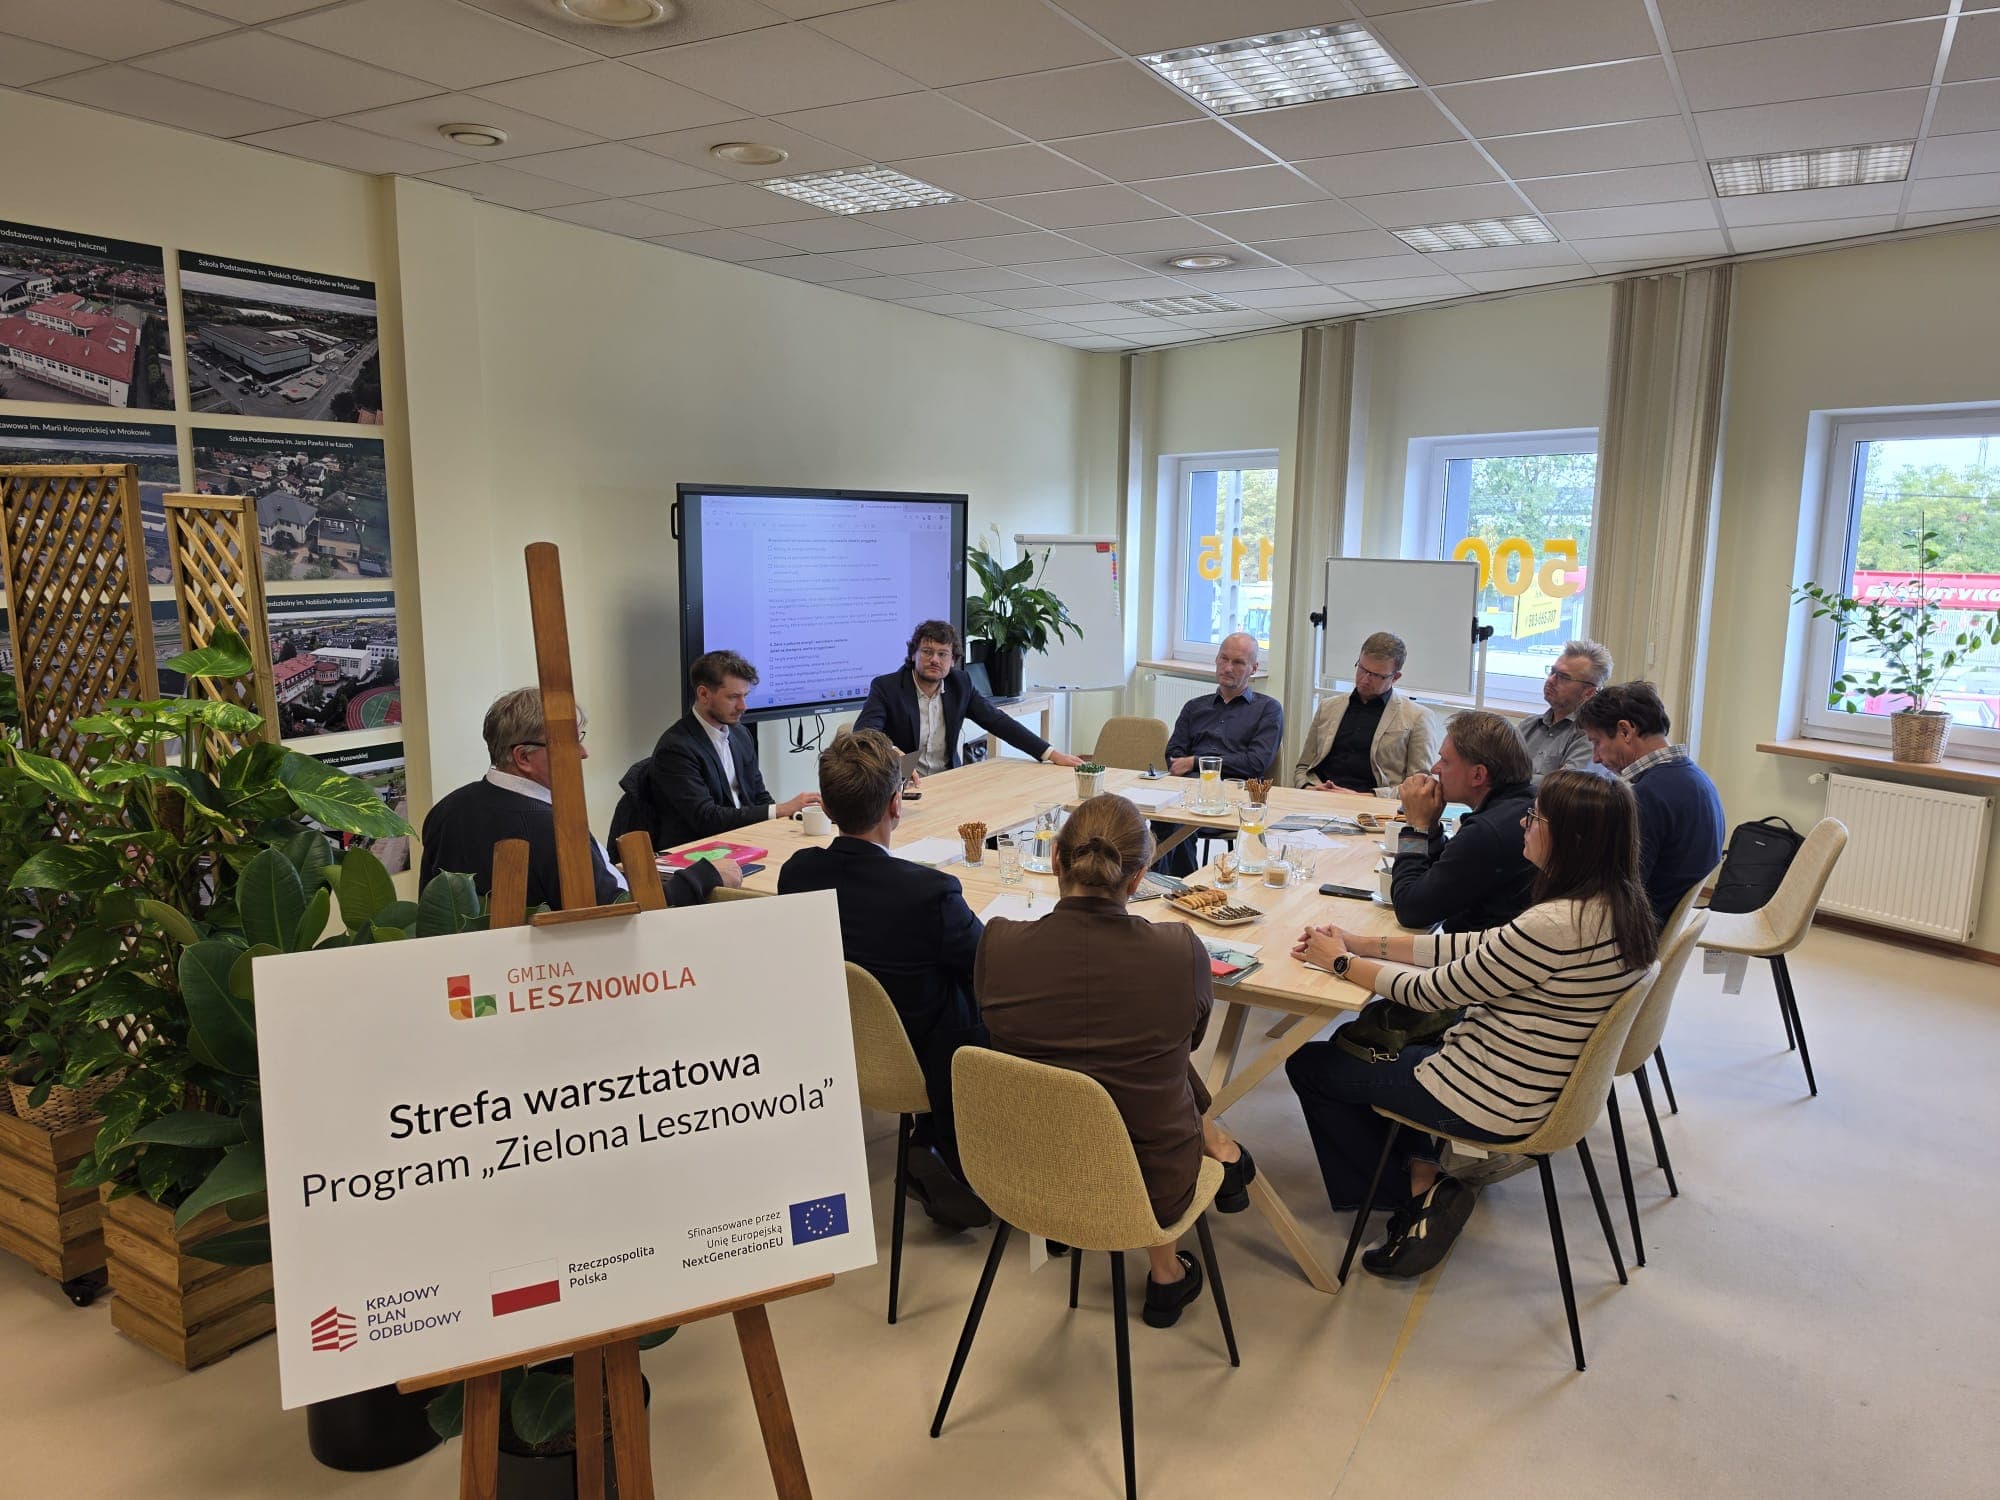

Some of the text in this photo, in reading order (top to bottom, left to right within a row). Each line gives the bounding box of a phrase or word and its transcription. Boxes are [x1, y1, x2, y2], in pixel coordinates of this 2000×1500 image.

[53, 236, 77, 248] Nowej
[219, 262, 257, 275] Podstawowa
[268, 270, 291, 281] Polskich
[0, 422, 28, 430] tawowa
[42, 423, 62, 432] Marii
[63, 425, 108, 435] Konopnickiej
[117, 428, 151, 436] Mrokowie
[249, 436, 285, 445] Podstawowa
[285, 437, 293, 445] im.
[295, 438, 306, 446] Jana
[507, 961, 575, 984] GMINA
[508, 966, 697, 1013] LESZNOWOLA
[389, 1052, 761, 1139] Strefa warsztatowa
[302, 1077, 834, 1207] Program „Zielona Lesznowola”
[687, 1210, 781, 1239] Sfinansowane przez
[706, 1223, 782, 1249] Unię Europejską
[568, 1246, 655, 1274] Rzeczpospolita
[682, 1237, 784, 1269] NextGenerationEU
[570, 1271, 608, 1288] Polska
[366, 1284, 440, 1312] KRAJOWY
[368, 1308, 406, 1326] PLAN
[369, 1311, 462, 1341] ODBUDOWY
